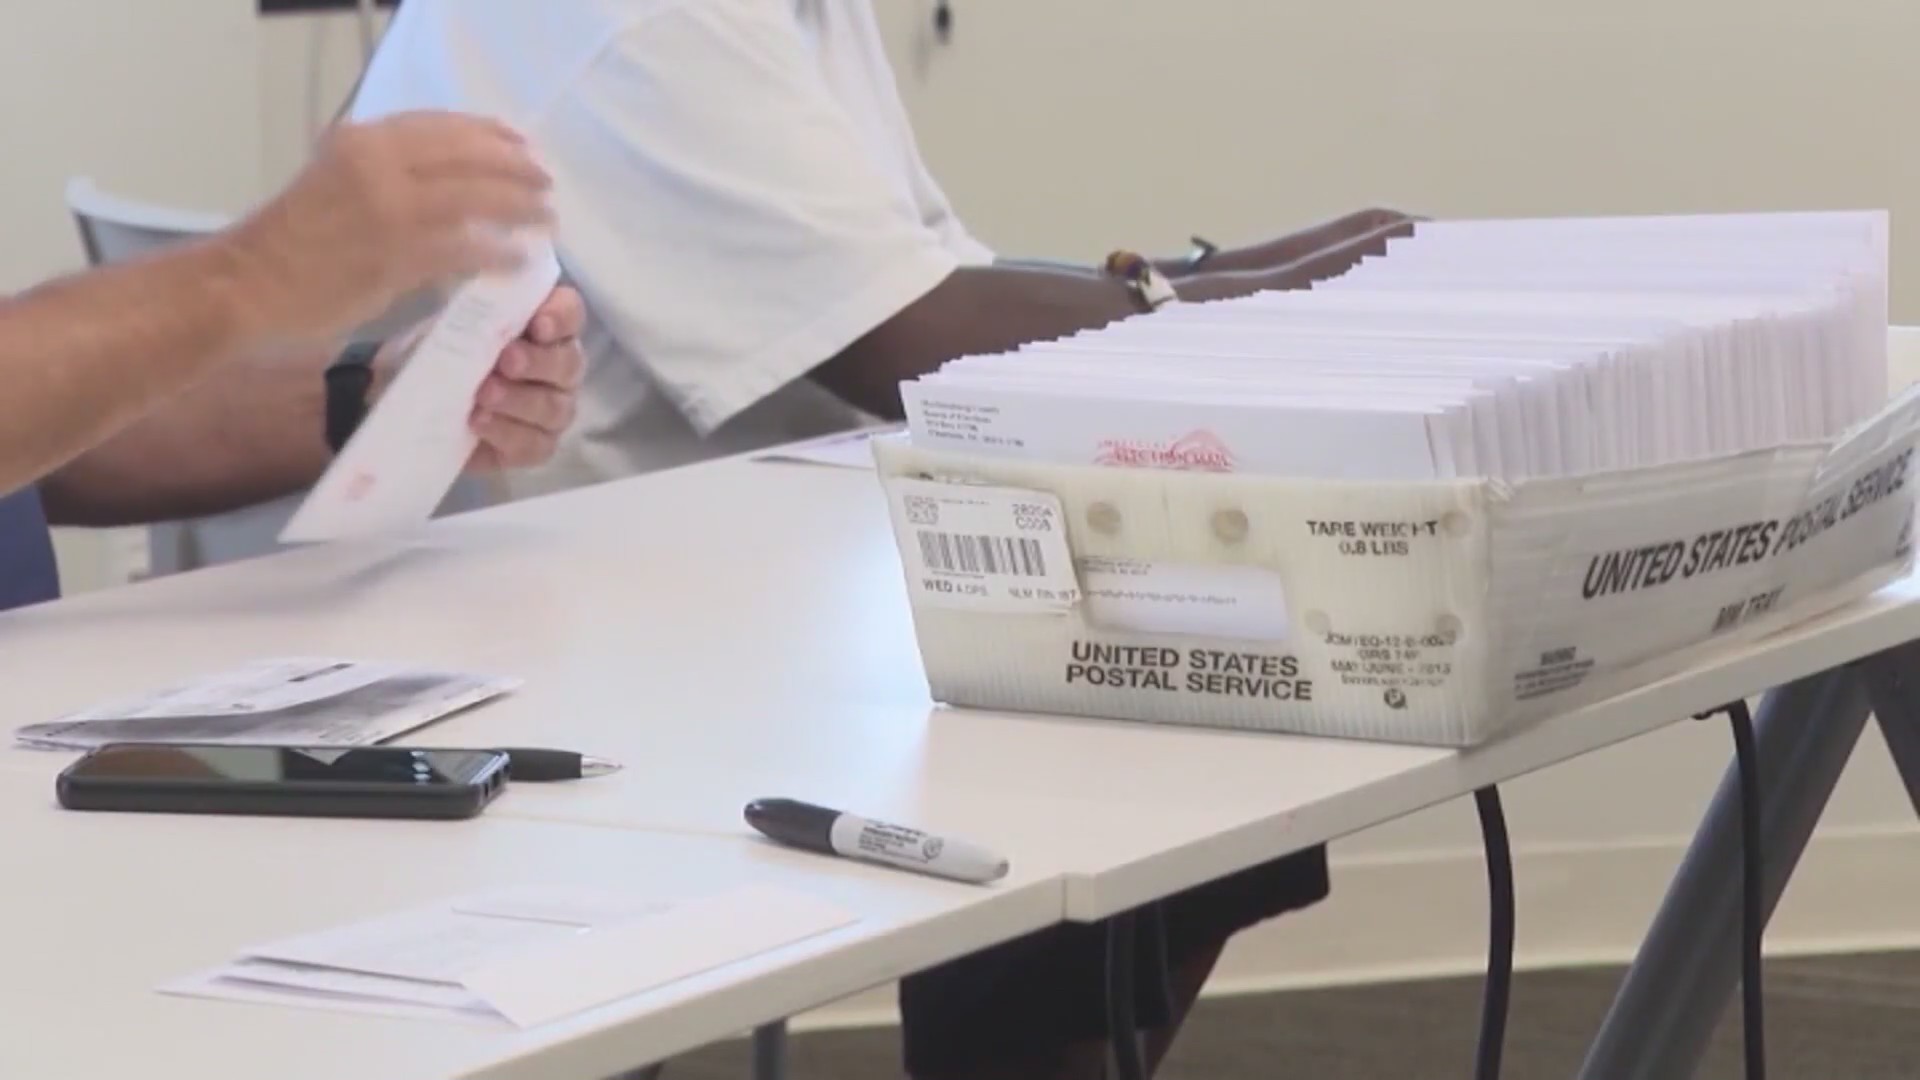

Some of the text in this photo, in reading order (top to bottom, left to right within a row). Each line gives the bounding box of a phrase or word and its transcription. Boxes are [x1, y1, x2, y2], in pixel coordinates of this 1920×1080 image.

[1305, 520, 1356, 538] TARE
[1582, 447, 1914, 600] UNITED STATES POSTAL SERVICE
[1072, 640, 1300, 678] UNITED STATES
[1065, 663, 1179, 692] POSTAL
[1186, 672, 1313, 702] SERVICE
